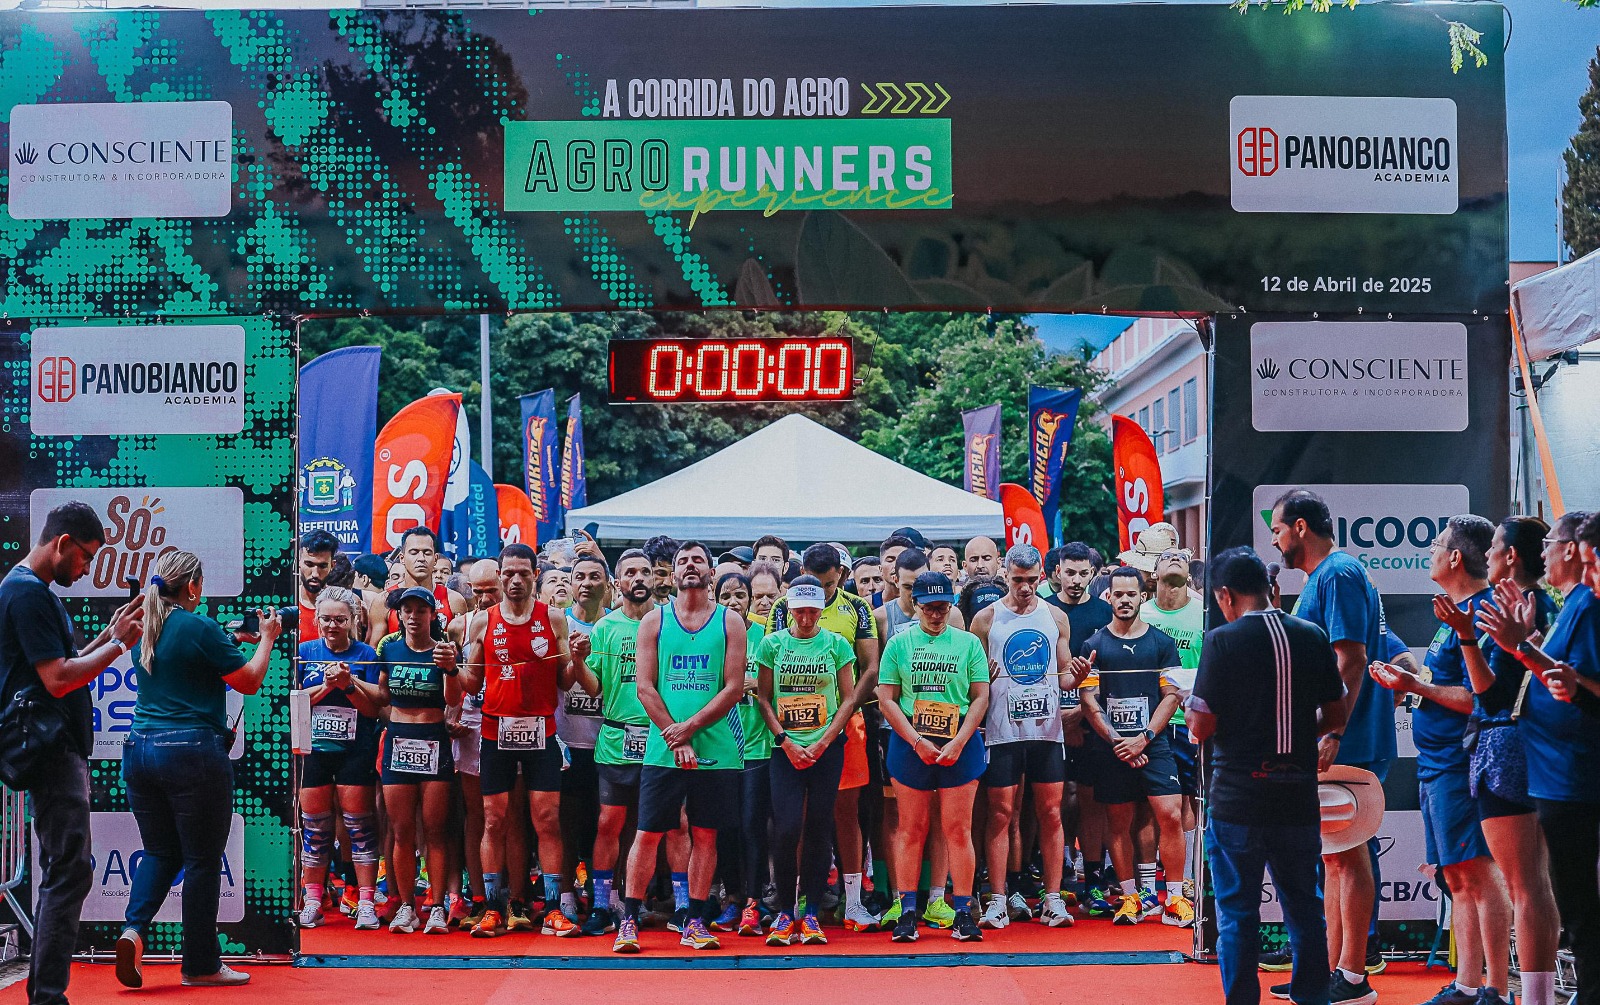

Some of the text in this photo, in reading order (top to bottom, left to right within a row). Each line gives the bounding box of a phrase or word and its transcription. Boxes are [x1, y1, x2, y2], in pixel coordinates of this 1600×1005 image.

[603, 76, 850, 118] A CORRIDA DO AGRO
[47, 139, 227, 165] CONSCIENTE
[1284, 135, 1451, 171] PANOBIANCO
[524, 138, 933, 193] AGRO RUNNERS
[20, 171, 226, 183] CONSTRUTORA & INCORPORADORA
[1373, 172, 1451, 183] ACADEMIA
[638, 175, 955, 232] experience
[1260, 276, 1432, 293] 12 de Abril de 2025
[649, 342, 848, 397] 0:00:00
[1288, 358, 1463, 381] CONSCIENTE
[81, 361, 238, 395] PANOBIANCO
[164, 396, 237, 405] ACADEMIA
[1263, 388, 1463, 398] CONSTRUTORA & INCORPORADORA
[299, 519, 359, 532] REFEITURA
[471, 483, 488, 557] Secovicred
[1338, 516, 1450, 549] ICOO
[93, 545, 180, 589] OUR
[1357, 553, 1432, 570] Secovic
[671, 654, 710, 670] CITY
[391, 664, 431, 681] CITY
[671, 683, 710, 692] RUNNERS
[571, 697, 600, 710] 5744
[1016, 698, 1045, 712] 5367
[787, 708, 815, 722] 1152
[920, 714, 948, 729] 1095
[1113, 711, 1138, 723] 5174
[317, 719, 347, 732] 5698
[505, 731, 536, 742] 5504
[399, 751, 429, 765] 5369
[102, 889, 130, 898] Associaçã
[219, 890, 236, 898] odão
